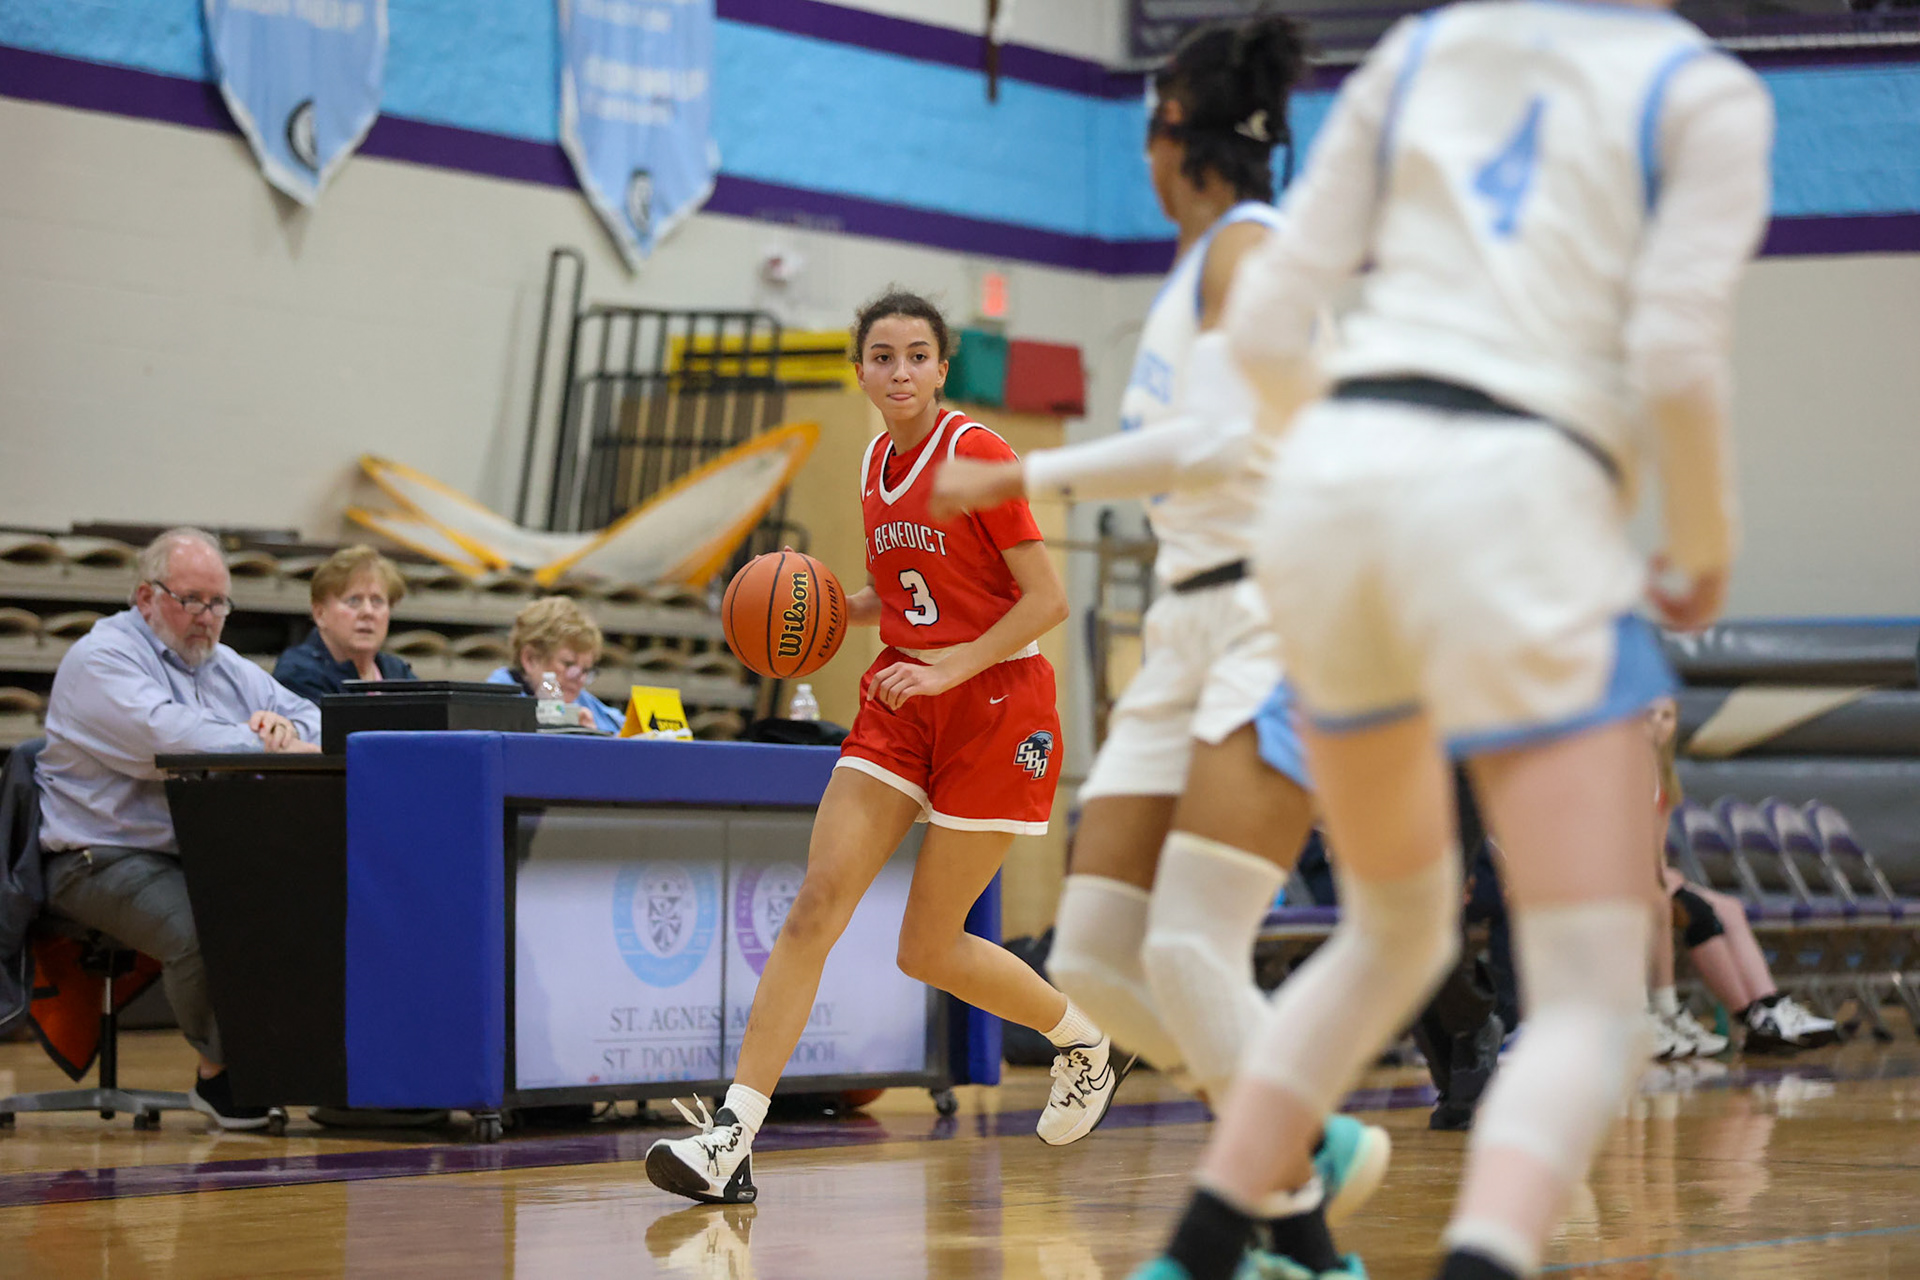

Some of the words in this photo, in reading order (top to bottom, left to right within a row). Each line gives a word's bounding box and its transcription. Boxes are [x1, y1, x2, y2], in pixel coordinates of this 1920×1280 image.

[1473, 95, 1545, 236] 4
[874, 521, 948, 556] BENEDICT
[777, 571, 809, 657] Wilson
[898, 568, 939, 627] 3
[1015, 742, 1048, 779] SBA
[648, 1005, 721, 1032] AGNES
